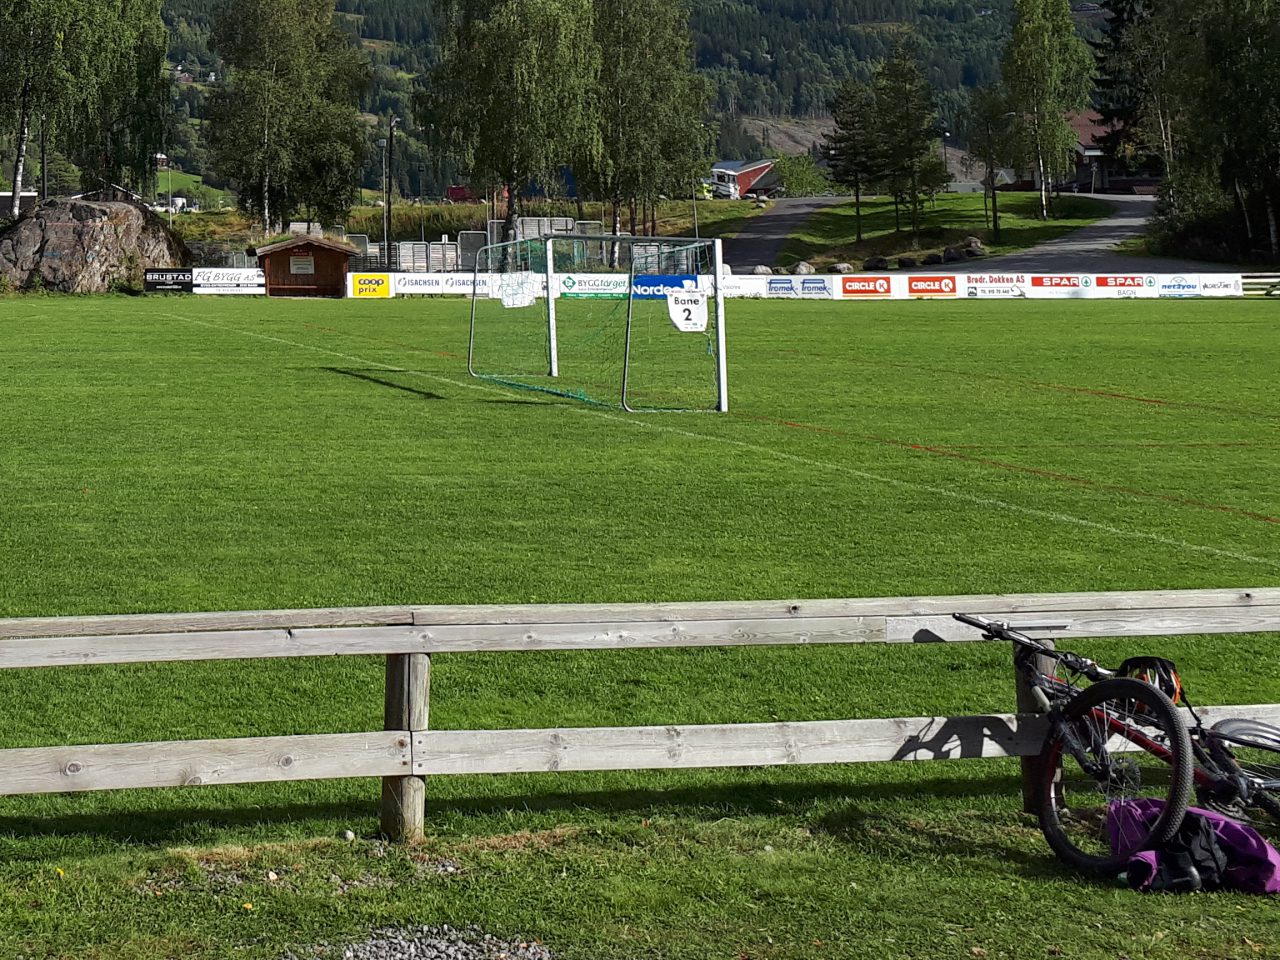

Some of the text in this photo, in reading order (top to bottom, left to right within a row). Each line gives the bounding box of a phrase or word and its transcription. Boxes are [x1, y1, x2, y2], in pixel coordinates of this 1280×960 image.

[194, 271, 213, 282] FG
[213, 273, 241, 282] BYGG
[989, 275, 1014, 283] Dokken
[1016, 275, 1024, 283] AS
[577, 280, 627, 289] BYGGtorget
[846, 282, 875, 290] CIRCLE
[912, 281, 940, 289] CIRCLE
[358, 286, 377, 295] prix
[674, 297, 699, 305] Bane
[683, 308, 692, 321] 2
